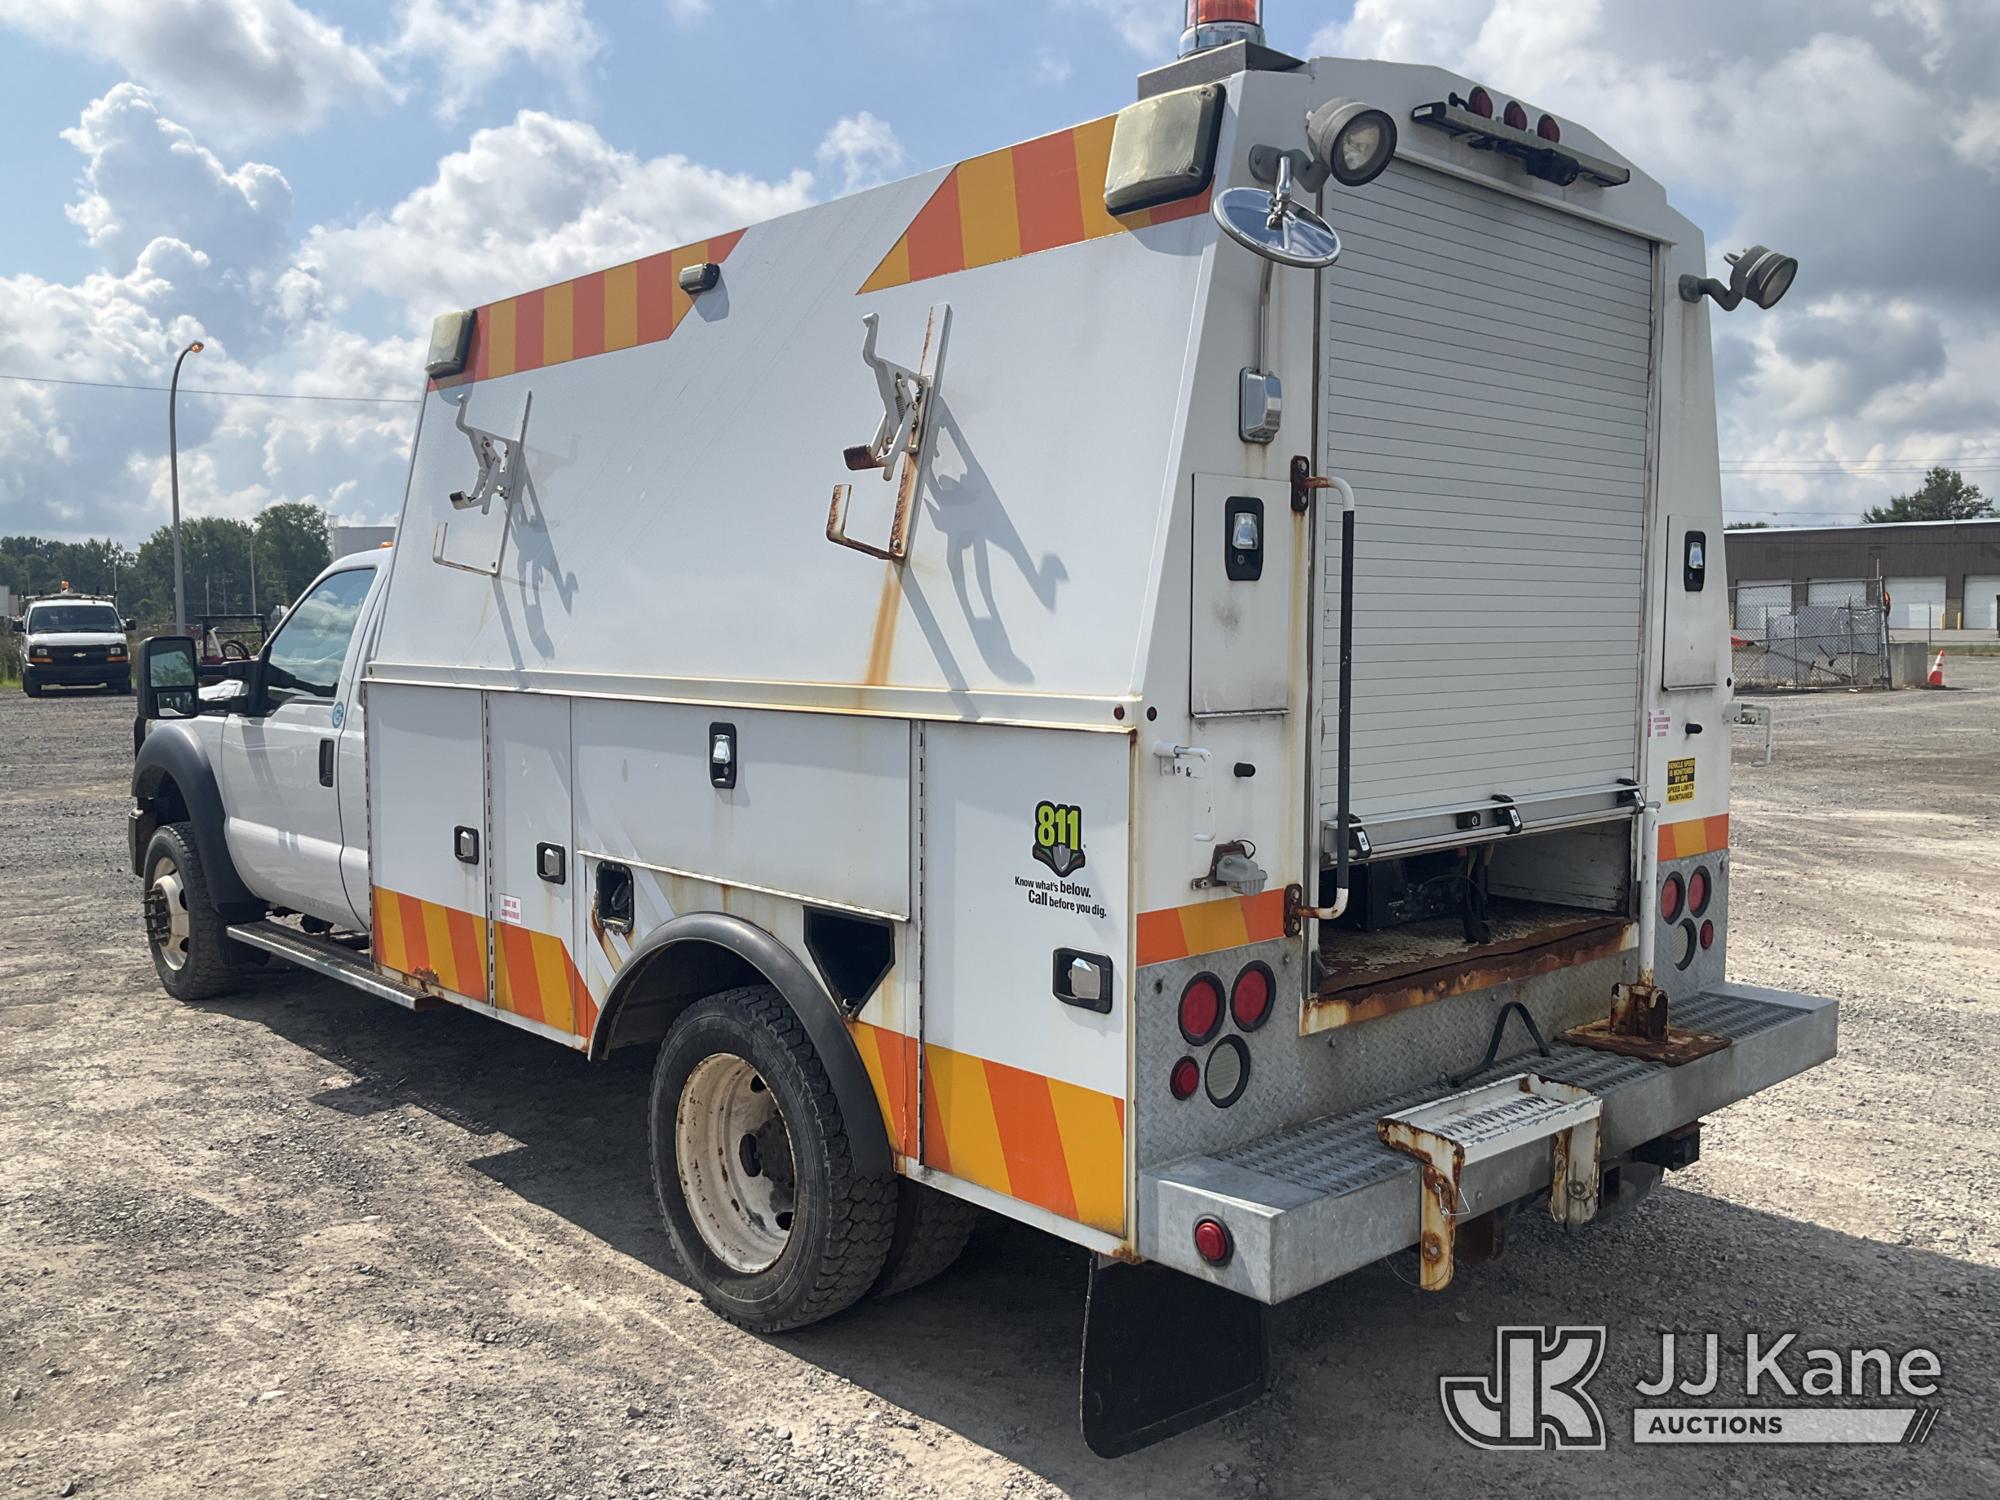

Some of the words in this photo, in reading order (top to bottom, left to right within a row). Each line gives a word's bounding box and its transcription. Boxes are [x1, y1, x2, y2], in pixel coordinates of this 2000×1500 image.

[1037, 804, 1079, 850] 811
[1015, 876, 1034, 888] Know
[1035, 881, 1058, 892] what's
[1060, 881, 1091, 898] below.
[1028, 889, 1047, 906] Call
[1049, 896, 1074, 911] before
[1076, 903, 1090, 914] you
[1091, 904, 1107, 919] dig.
